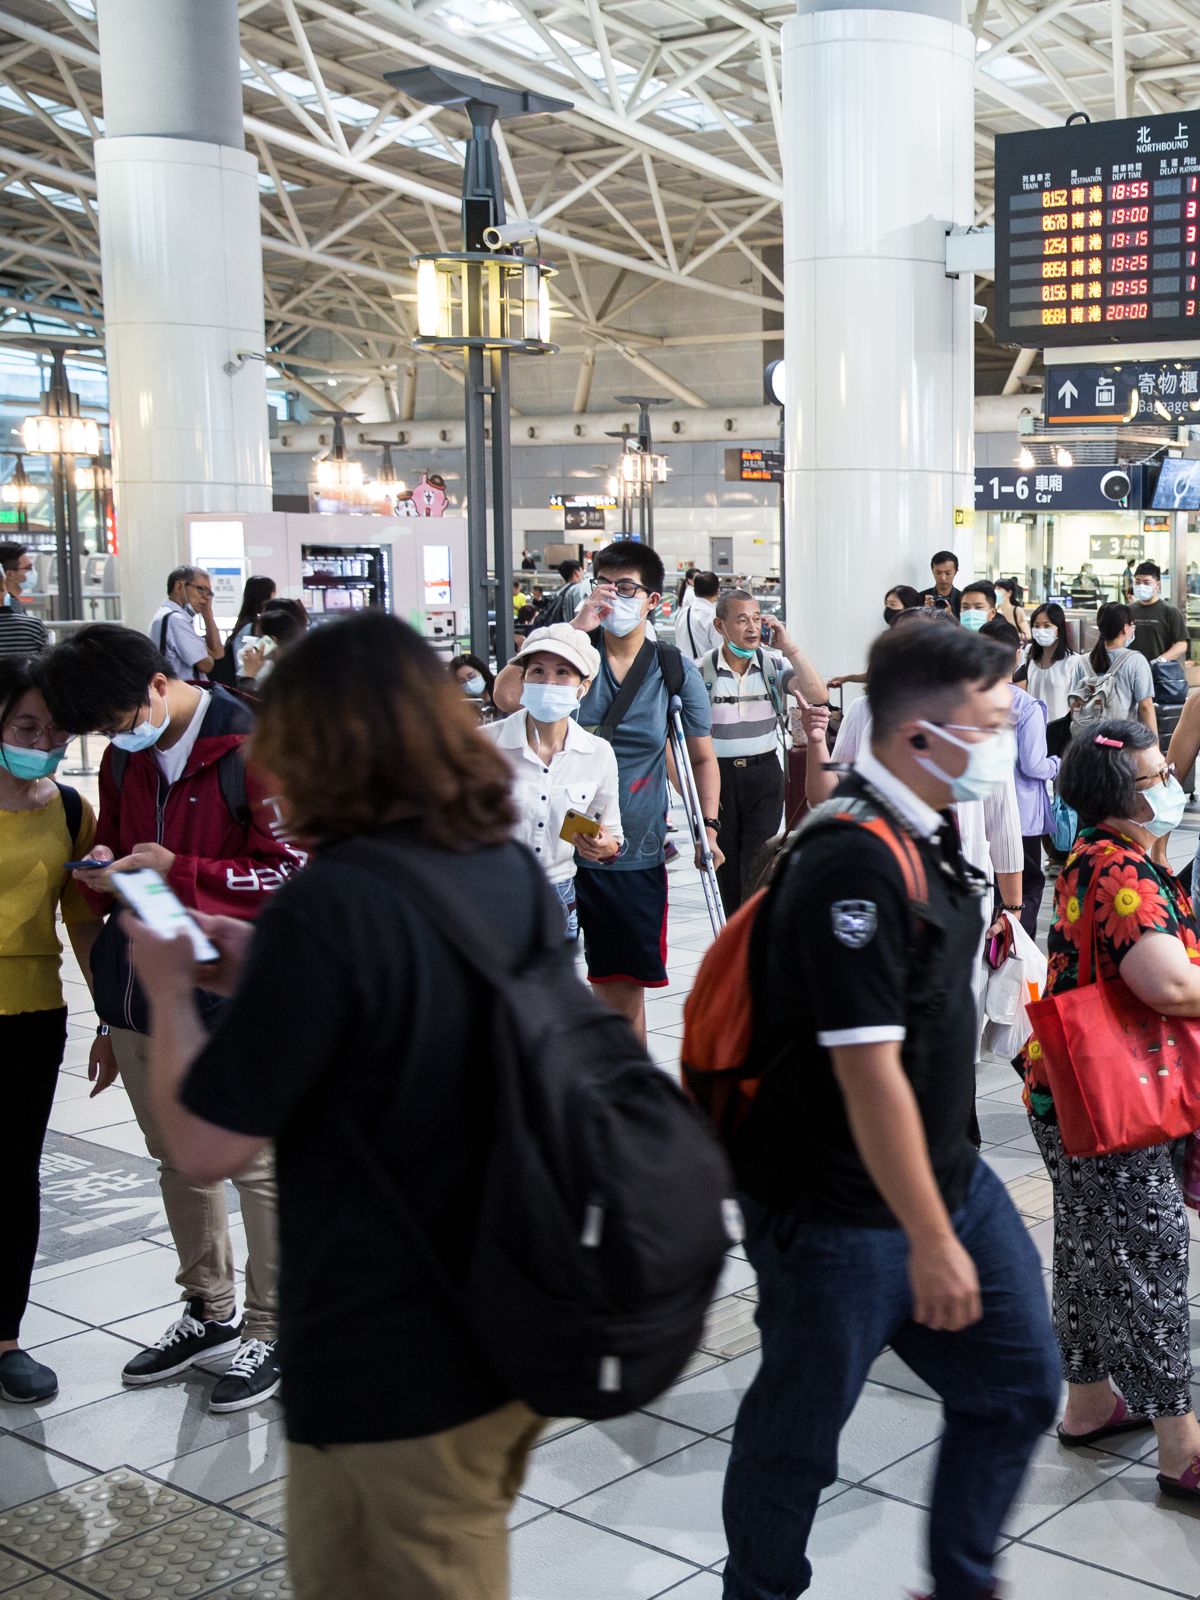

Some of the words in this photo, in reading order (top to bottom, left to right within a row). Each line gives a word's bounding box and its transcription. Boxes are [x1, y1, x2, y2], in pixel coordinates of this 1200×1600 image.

[1137, 122, 1188, 144] 北上
[1136, 140, 1188, 153] NORTHBOUND
[1112, 172, 1127, 181] DEPT
[1128, 171, 1142, 179] TIME
[1160, 167, 1178, 176] DELAY
[1179, 165, 1200, 173] PLATFORM
[1023, 180, 1039, 190] TRAIN
[1044, 180, 1051, 188] ID
[1071, 176, 1102, 185] DESTINATION
[1042, 190, 1067, 207] 0152
[1071, 185, 1102, 205] 南港
[1111, 182, 1148, 200] 18:55
[1071, 210, 1102, 229] 南港
[1111, 206, 1148, 224] 19:00
[1187, 202, 1196, 218] 3
[1043, 237, 1067, 255] 1254
[1071, 233, 1102, 253] 南港
[1111, 231, 1148, 248] 19:15
[1186, 226, 1196, 242] 3
[1071, 257, 1102, 277] 南港
[1111, 255, 1148, 272] 19:25
[1042, 284, 1067, 301] 0156
[1071, 281, 1102, 300] 南港
[1111, 279, 1148, 296] 19:55
[1070, 304, 1101, 324] 南港
[1106, 303, 1148, 321] 20:00
[1186, 301, 1195, 316] 3
[1138, 371, 1198, 395] 寄物櫃
[989, 476, 1029, 500] 1-6
[1035, 474, 1062, 492] 車廂
[1035, 493, 1052, 503] Car
[1109, 537, 1120, 555] 3
